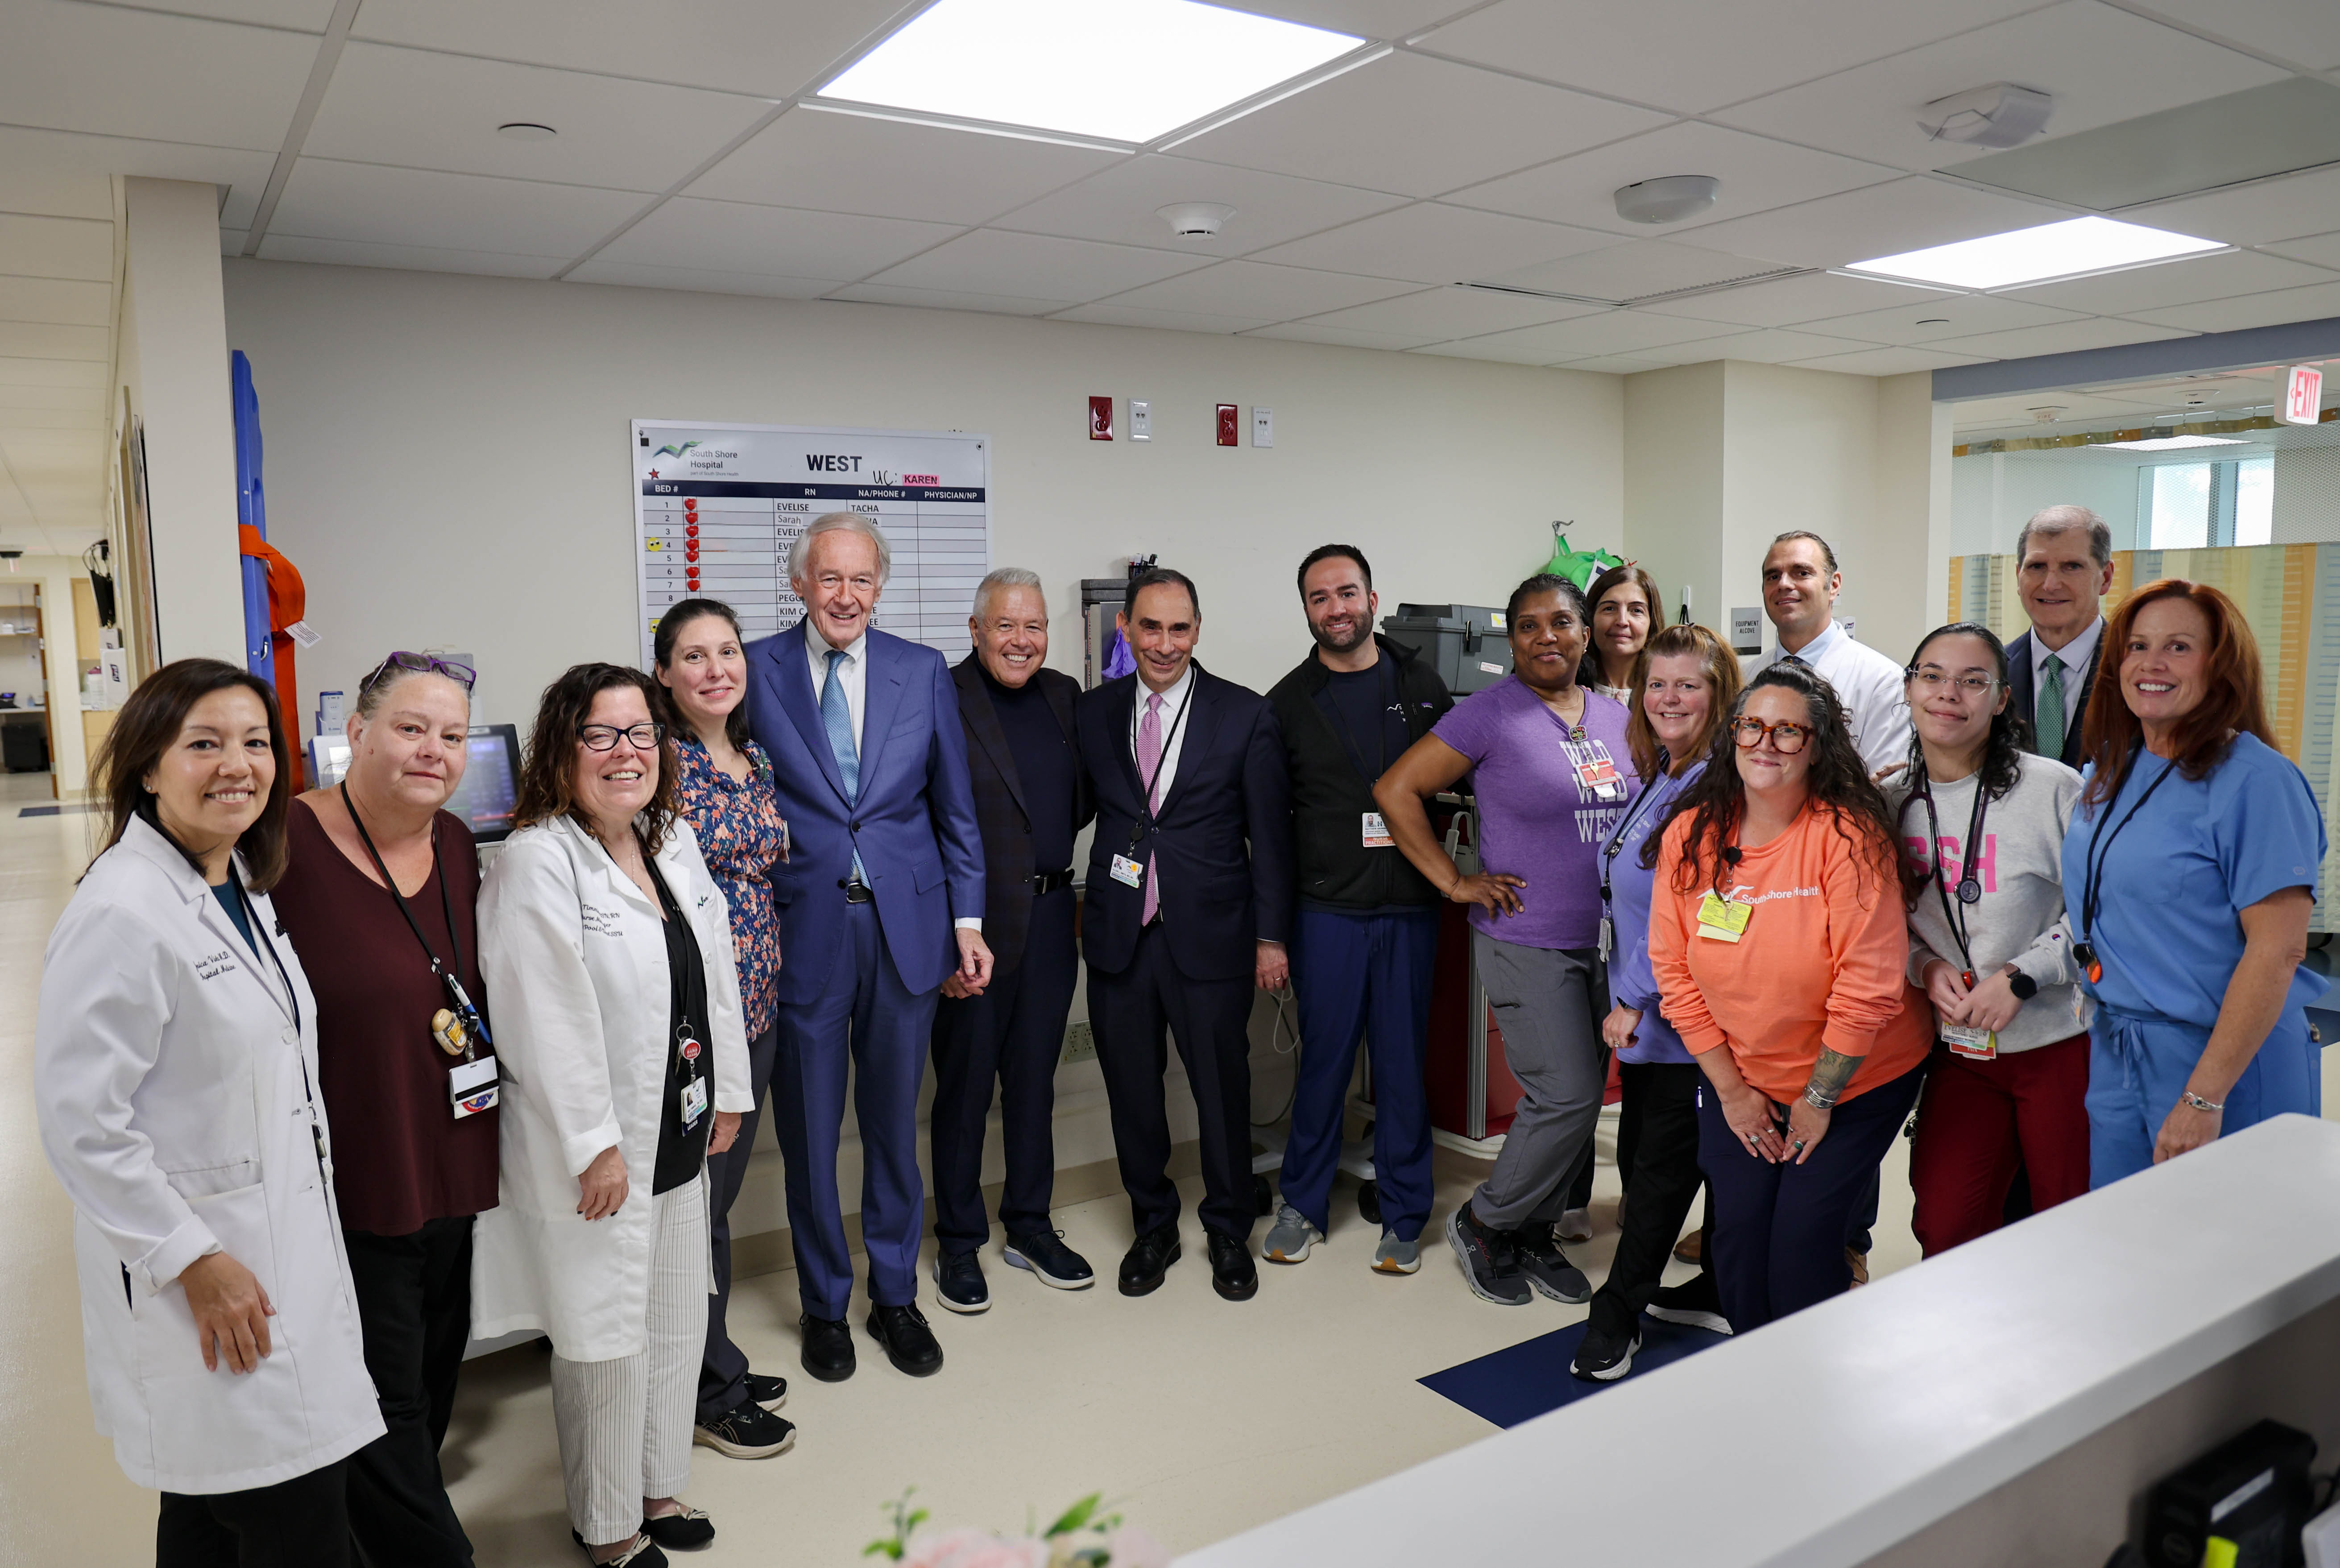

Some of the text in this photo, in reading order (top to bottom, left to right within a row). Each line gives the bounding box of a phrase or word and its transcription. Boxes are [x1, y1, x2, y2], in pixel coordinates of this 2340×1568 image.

[2294, 371, 2319, 419] EXIT
[715, 450, 737, 458] Shore
[691, 460, 723, 469] Hospital
[806, 454, 862, 472] WEST
[904, 475, 938, 484] KAREN
[655, 484, 671, 492] BED
[858, 489, 899, 498] NA/PHONE
[924, 491, 977, 499] PHYSICIAN/NP
[777, 503, 809, 511] EVELISE
[778, 515, 801, 524] Sarah
[1571, 771, 1628, 803] WD
[1741, 894, 1766, 904] South
[688, 1119, 698, 1131] LEADER
